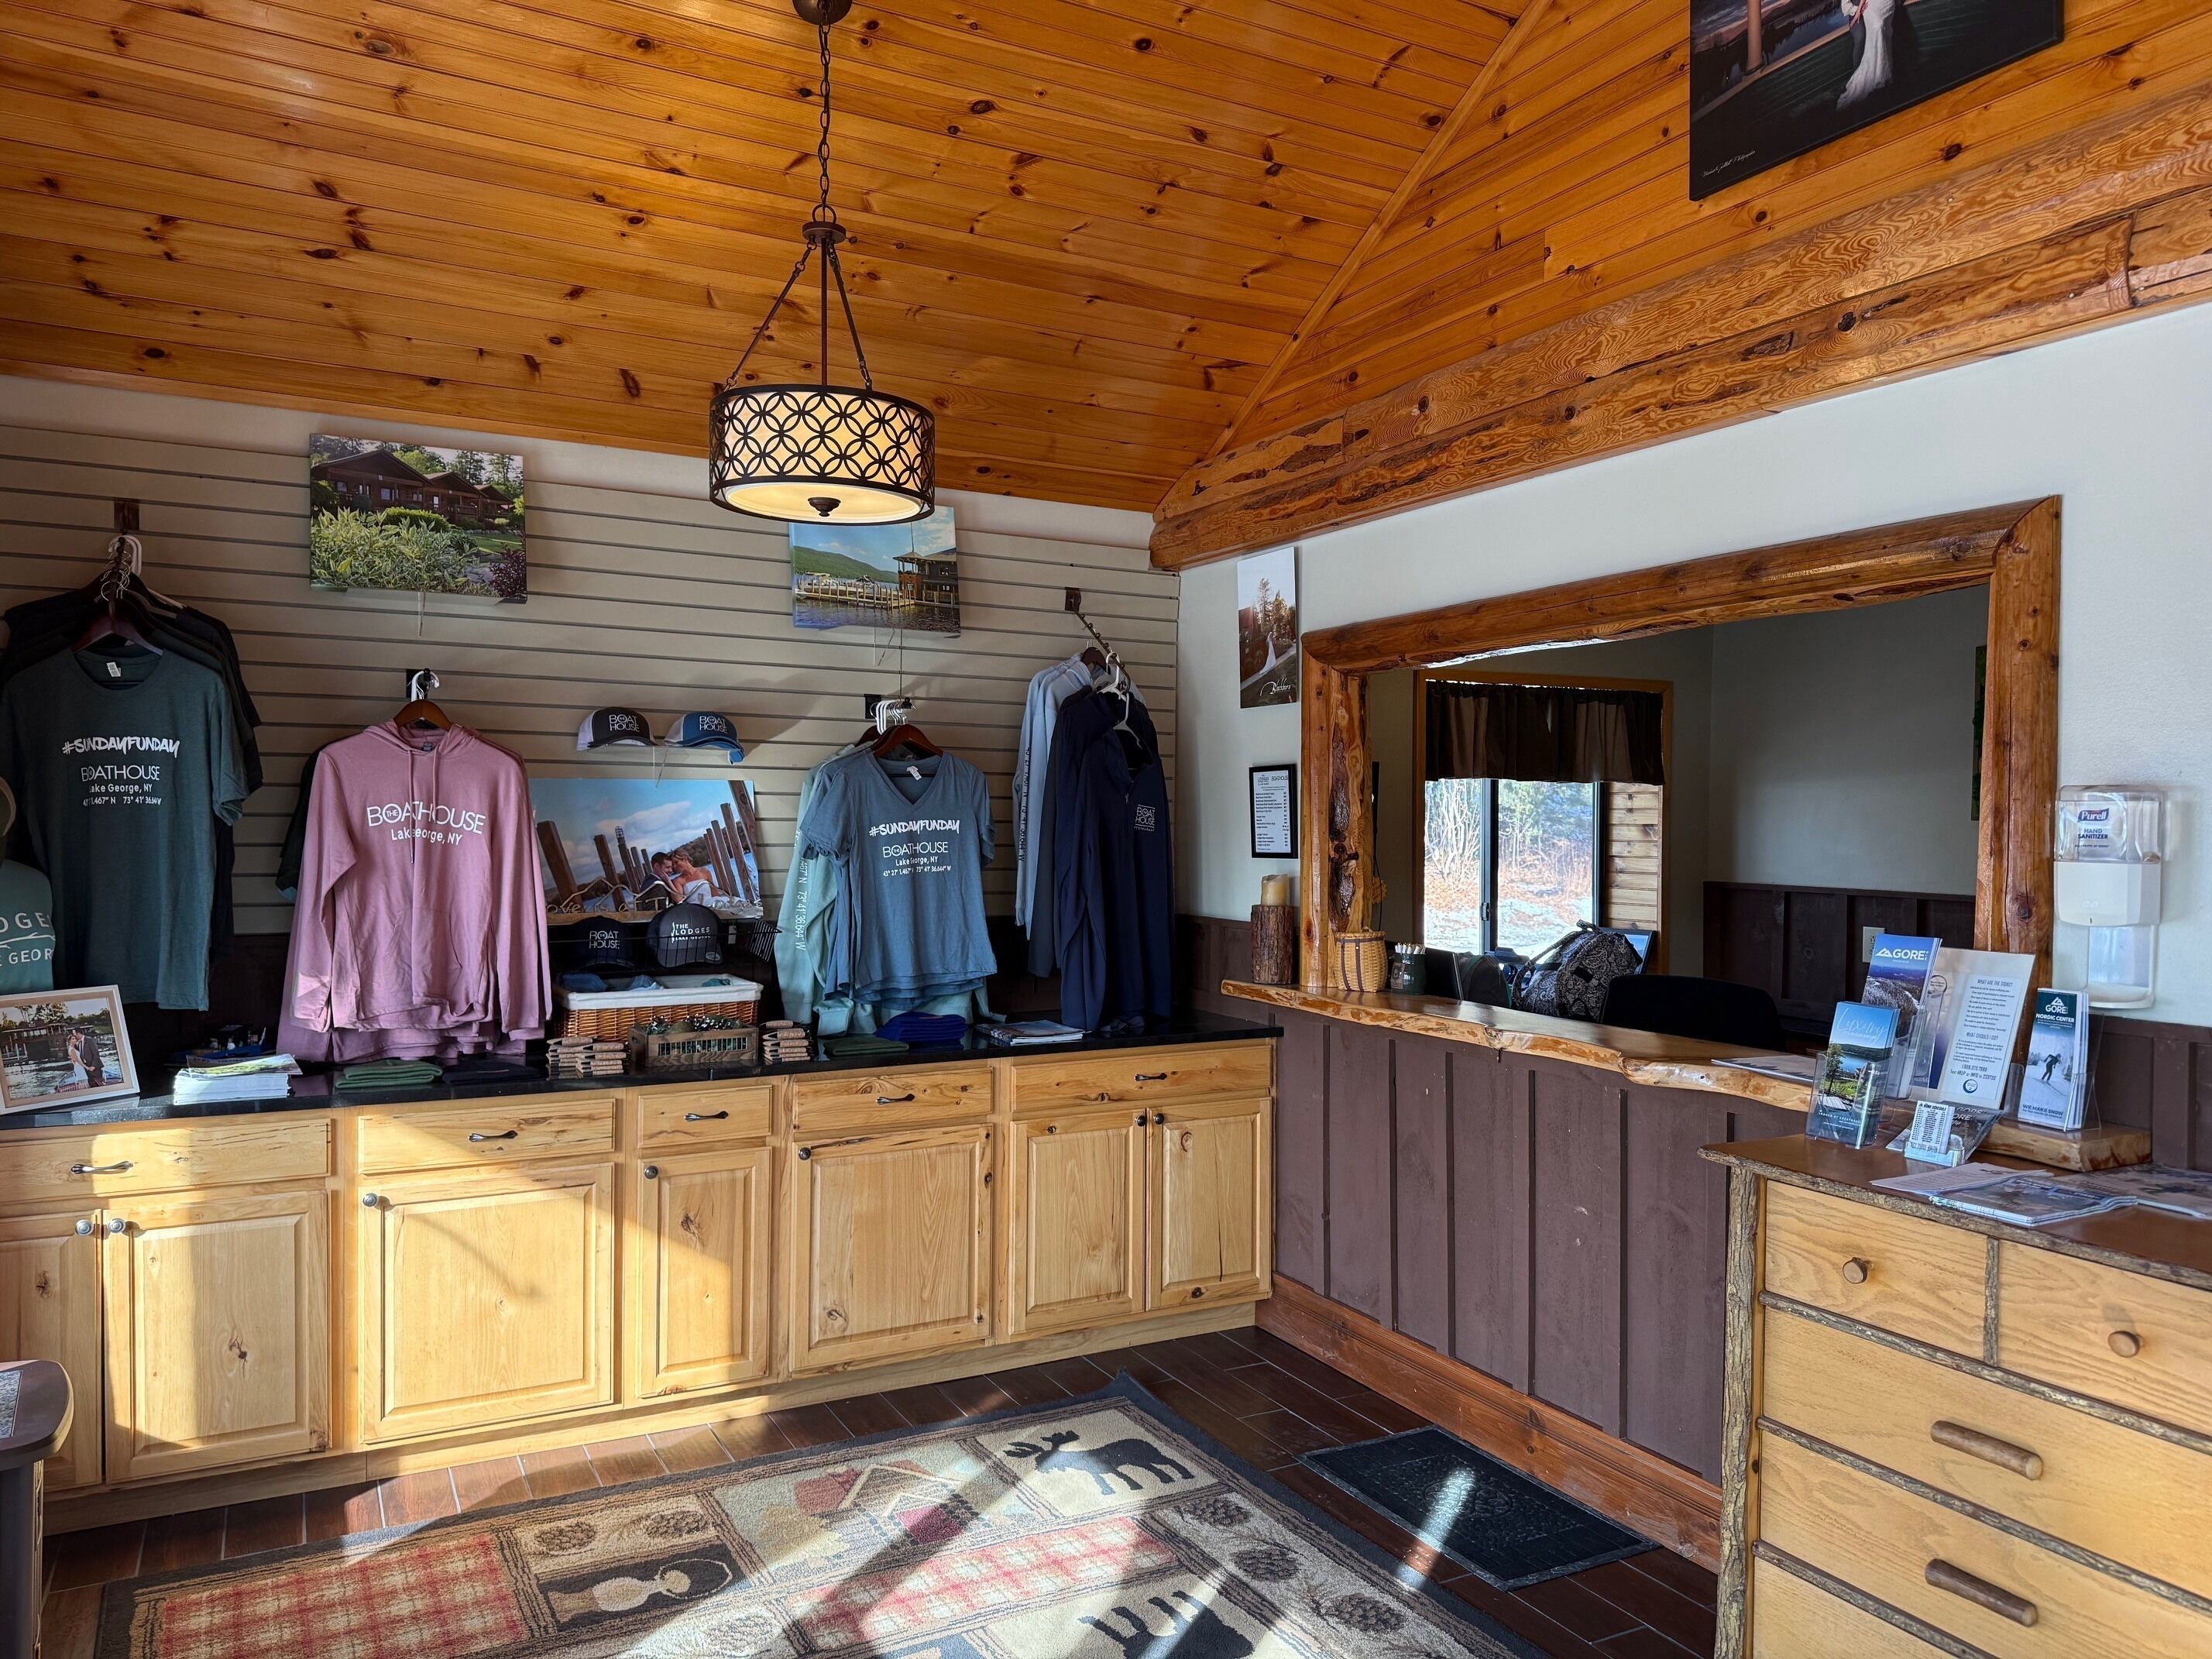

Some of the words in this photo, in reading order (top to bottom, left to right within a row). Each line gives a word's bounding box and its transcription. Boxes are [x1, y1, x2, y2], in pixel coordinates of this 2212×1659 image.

[609, 714, 637, 724] BOAT
[699, 716, 725, 726] BOAT
[610, 723, 640, 732] HOUSE
[699, 723, 728, 733] HOUSE
[62, 736, 180, 758] #SUNDAYFUNDAY
[81, 764, 160, 782] BOATHOUSE
[108, 784, 142, 794] George,
[143, 783, 153, 792] NY
[2081, 811, 2107, 820] Purell
[869, 819, 960, 836] #SUNDAYFUNDAY
[447, 833, 463, 846] NY
[883, 841, 949, 858] BOATHOUSE
[895, 857, 910, 867] Lake
[589, 930, 619, 940] BOAT
[675, 926, 710, 936] LODGES
[795, 941, 806, 950] W
[9, 948, 54, 965] GEOR
[1892, 948, 1926, 960] GORE
[2045, 1004, 2066, 1015] GORE
